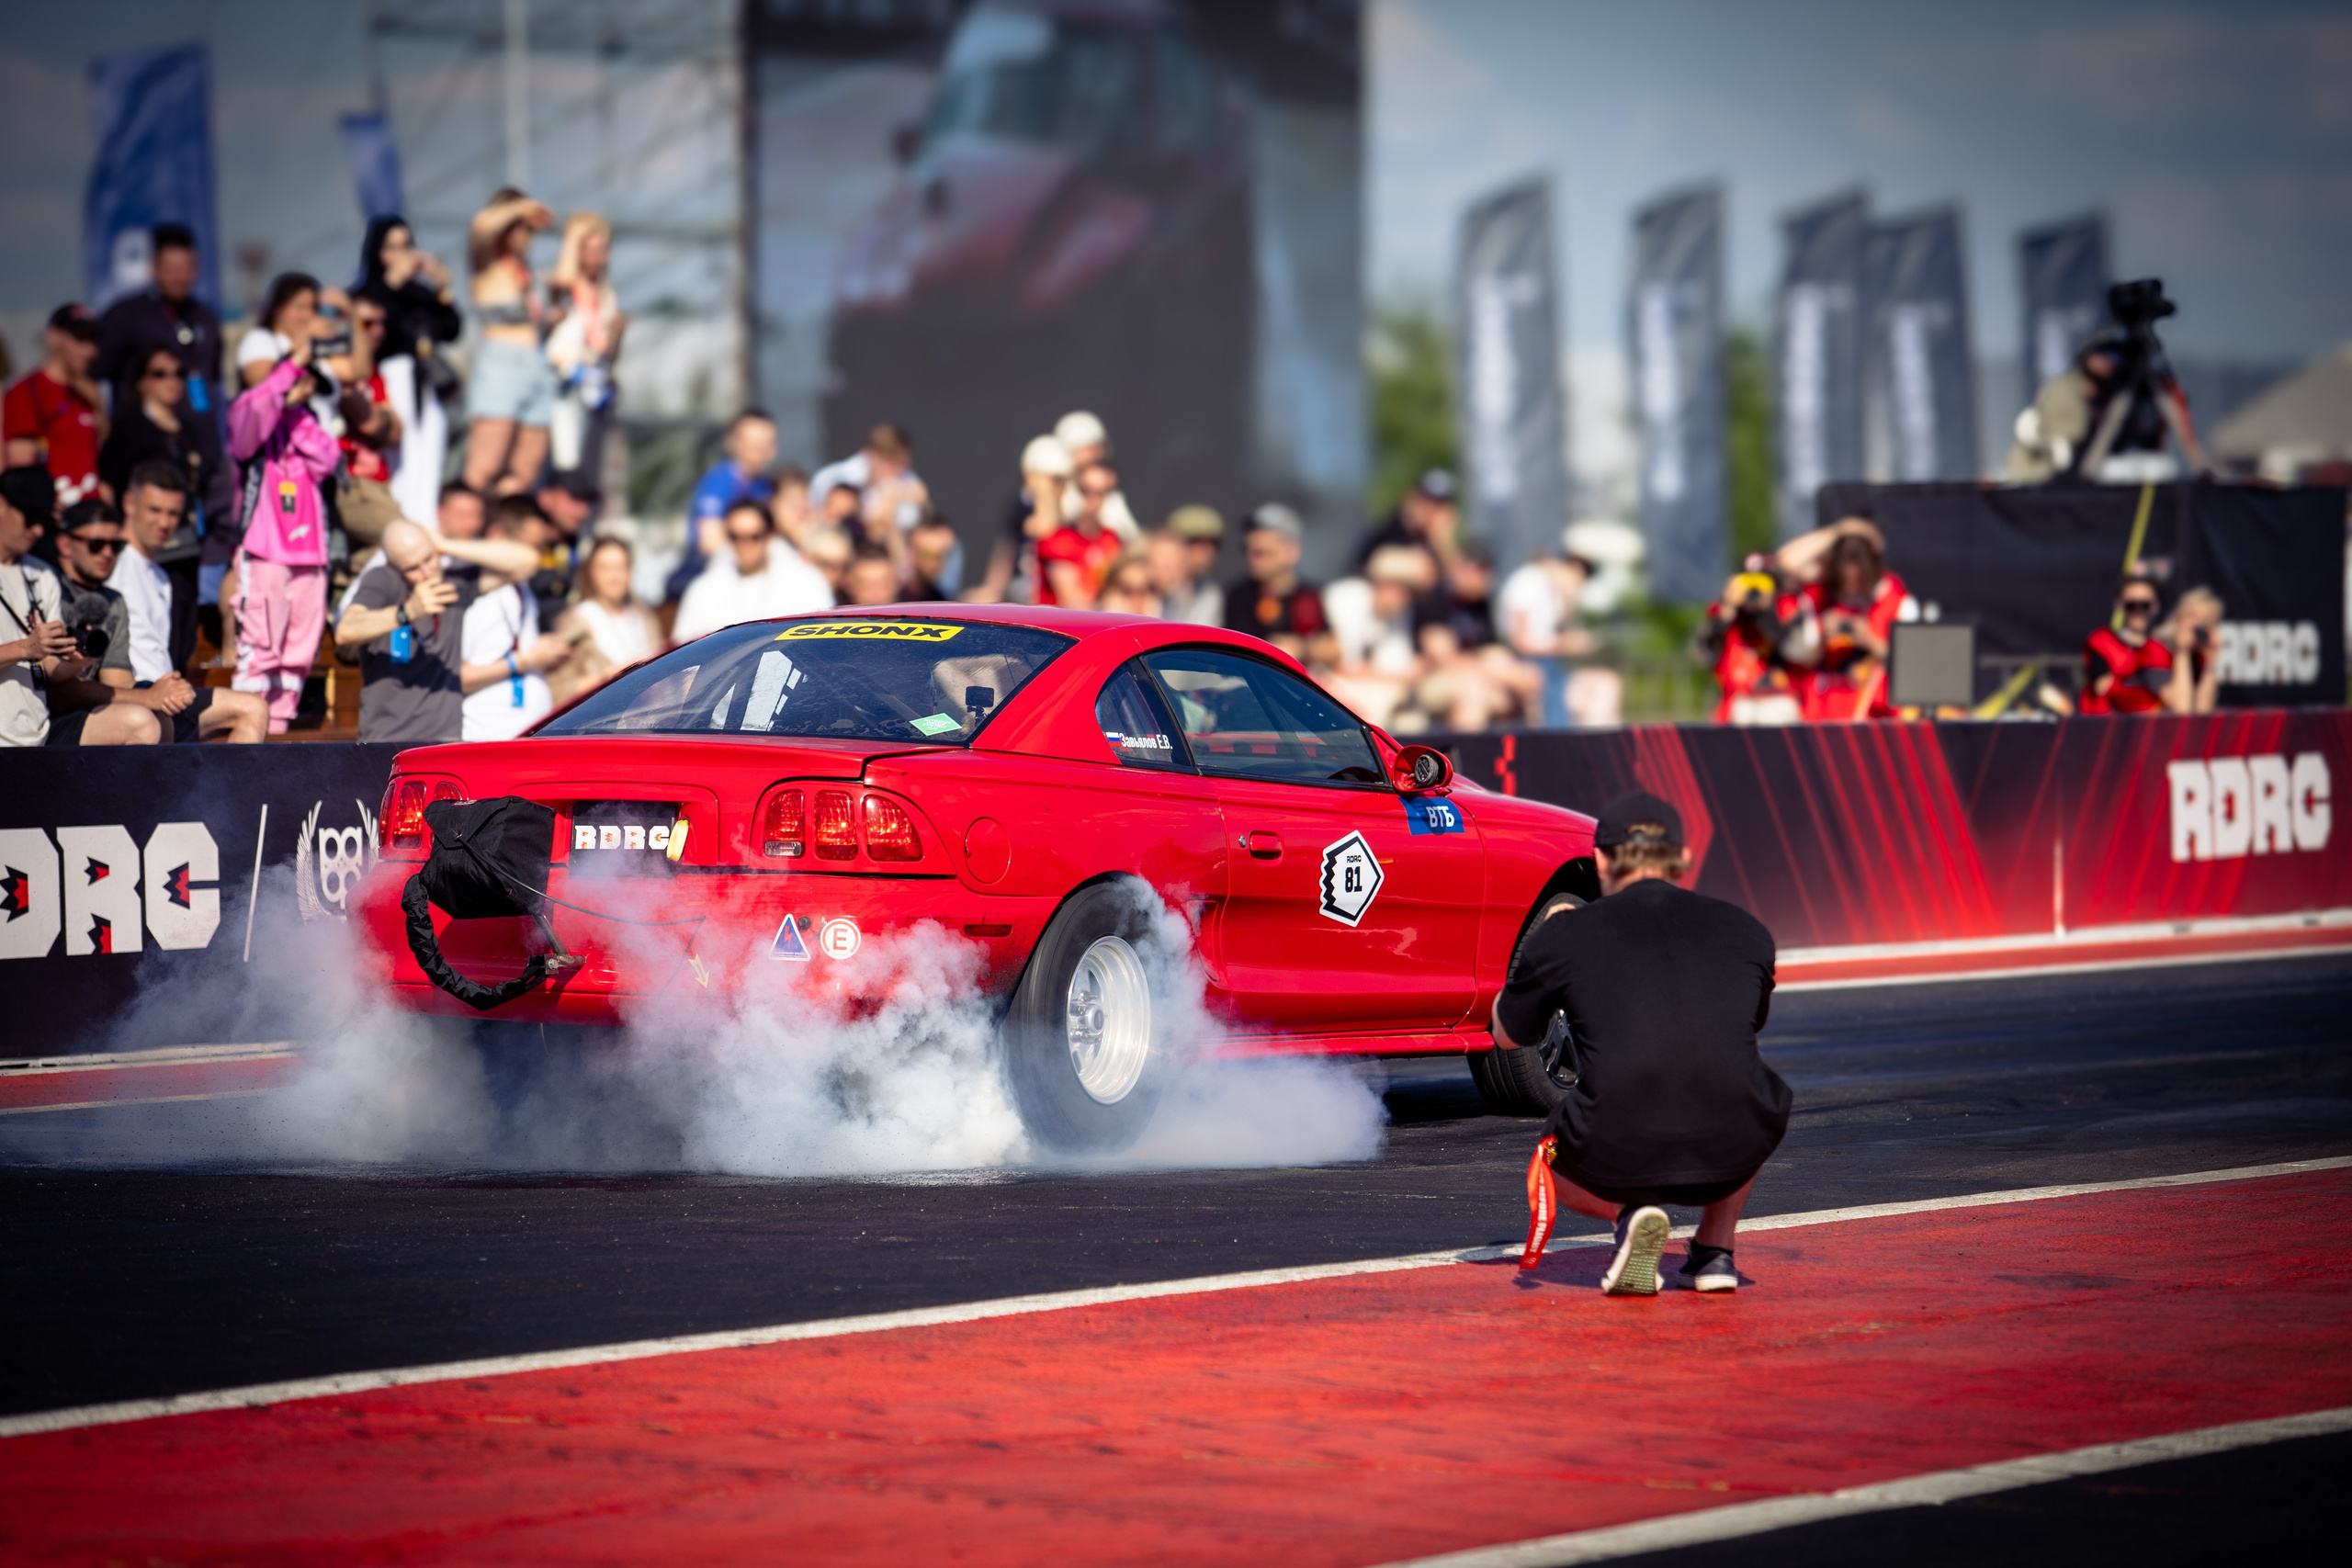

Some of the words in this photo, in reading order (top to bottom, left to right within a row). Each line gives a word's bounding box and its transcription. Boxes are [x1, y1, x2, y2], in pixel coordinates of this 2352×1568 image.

[788, 626, 951, 638] SHONX
[2218, 621, 2321, 684] RDRC
[1118, 732, 1158, 749] Завьялов
[1425, 805, 1455, 828] ВТБ
[2167, 753, 2331, 862] RDRC
[574, 825, 671, 851] RDRC
[1346, 854, 1362, 863] RDRC
[1345, 865, 1363, 894] 81
[832, 928, 848, 951] E
[1530, 1222, 1547, 1253] FLIGHT
